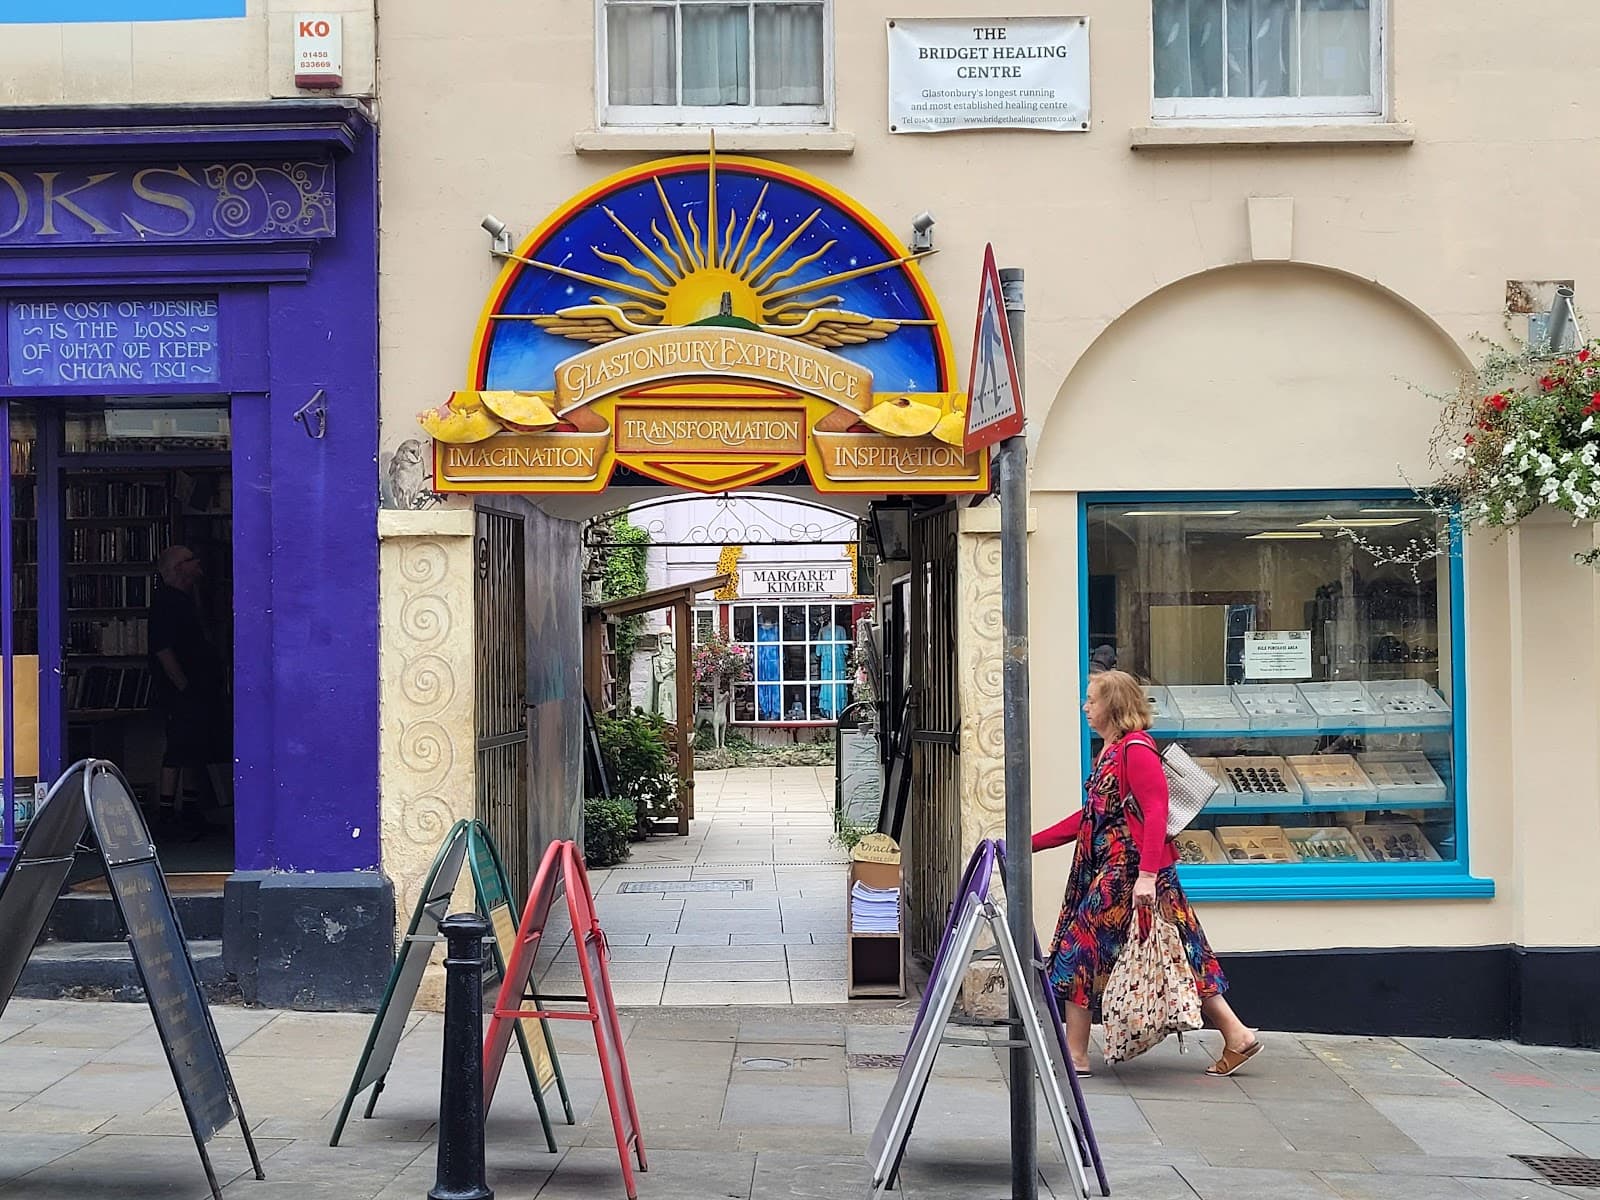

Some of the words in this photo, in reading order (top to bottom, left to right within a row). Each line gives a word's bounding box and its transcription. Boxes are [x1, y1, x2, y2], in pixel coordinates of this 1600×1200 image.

[299, 21, 330, 37] KO
[973, 28, 1006, 40] THE
[919, 47, 989, 60] BRIDGET
[993, 46, 1067, 59] HEALING
[957, 66, 1022, 79] CENTRE
[921, 89, 984, 99] Glastonbury's
[985, 89, 1017, 98] longest
[1019, 88, 1055, 98] running
[911, 102, 927, 111] and
[929, 102, 951, 111] most
[953, 101, 1004, 110] established
[1005, 101, 1038, 111] healing
[964, 115, 1077, 124] www.bridgethealingcentre.co.uk
[63, 301, 114, 320] COST
[118, 301, 145, 318] OF
[50, 322, 68, 339] IS
[73, 321, 119, 339] THE
[134, 321, 187, 340] LOSS
[23, 344, 51, 360] OF
[60, 343, 116, 360] WHAT
[123, 343, 151, 359] WE
[59, 362, 143, 381] CHUANG
[151, 362, 186, 378] TSU
[564, 340, 728, 400] GLASTONBURY
[720, 337, 859, 399] EXPERIENCE
[624, 420, 799, 446] TRANSFORMATION
[449, 447, 594, 467] IMAGINATION
[834, 446, 966, 474] INSPIRATION
[753, 570, 836, 582] MARGARET
[768, 582, 825, 593] KIMBER
[860, 841, 896, 854] Oracl
